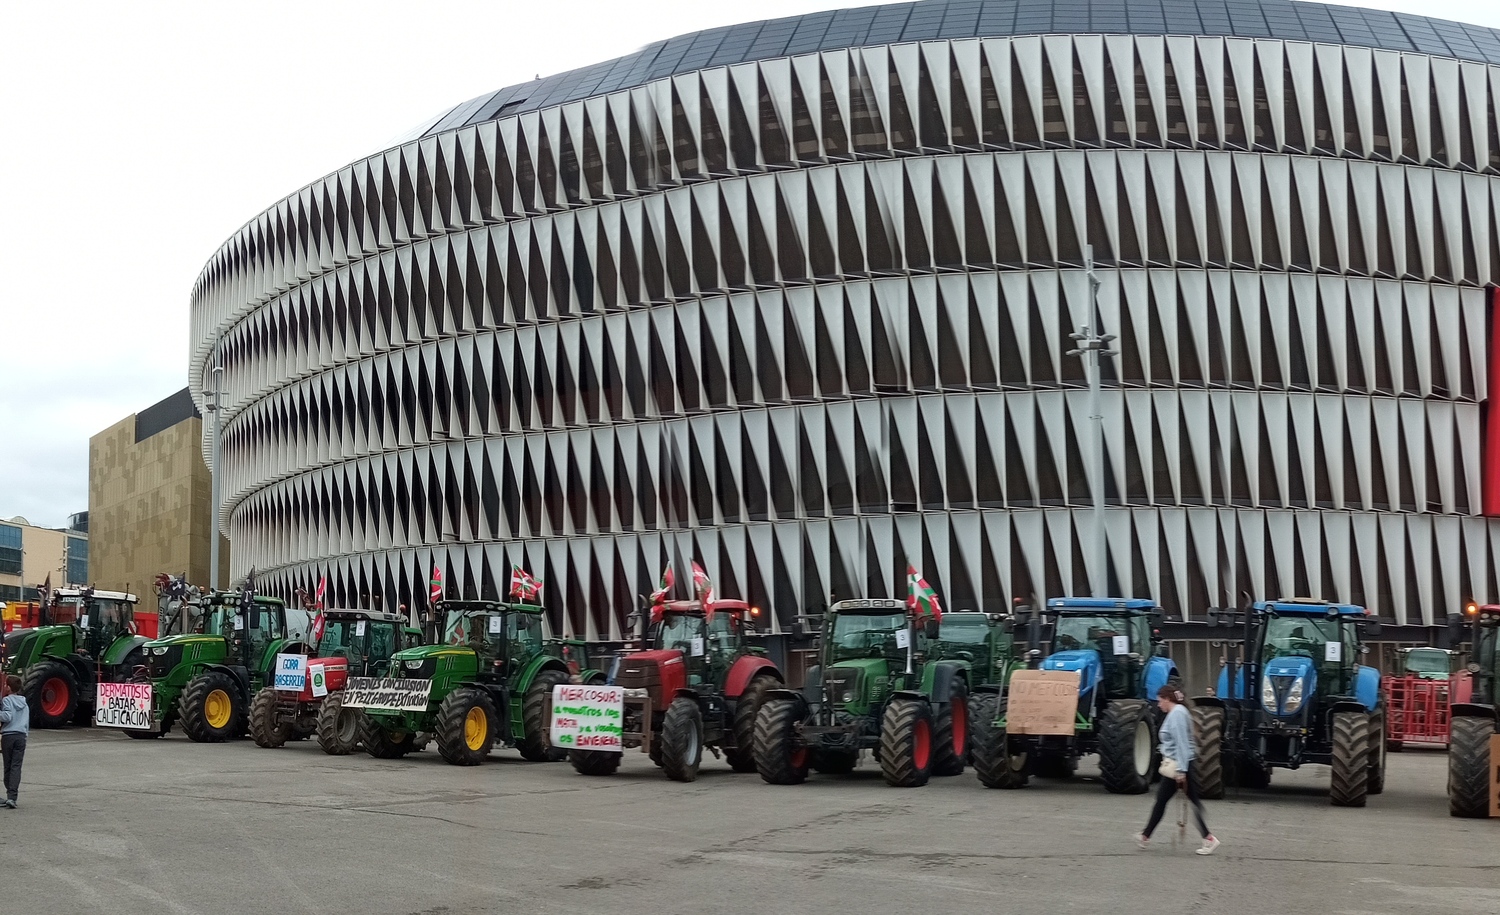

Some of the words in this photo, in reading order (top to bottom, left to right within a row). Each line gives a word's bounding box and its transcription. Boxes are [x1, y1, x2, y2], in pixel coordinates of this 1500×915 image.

[108, 697, 136, 710] BAJAR
[342, 691, 355, 705] EN
[97, 708, 151, 726] CALIFICACIÓN
